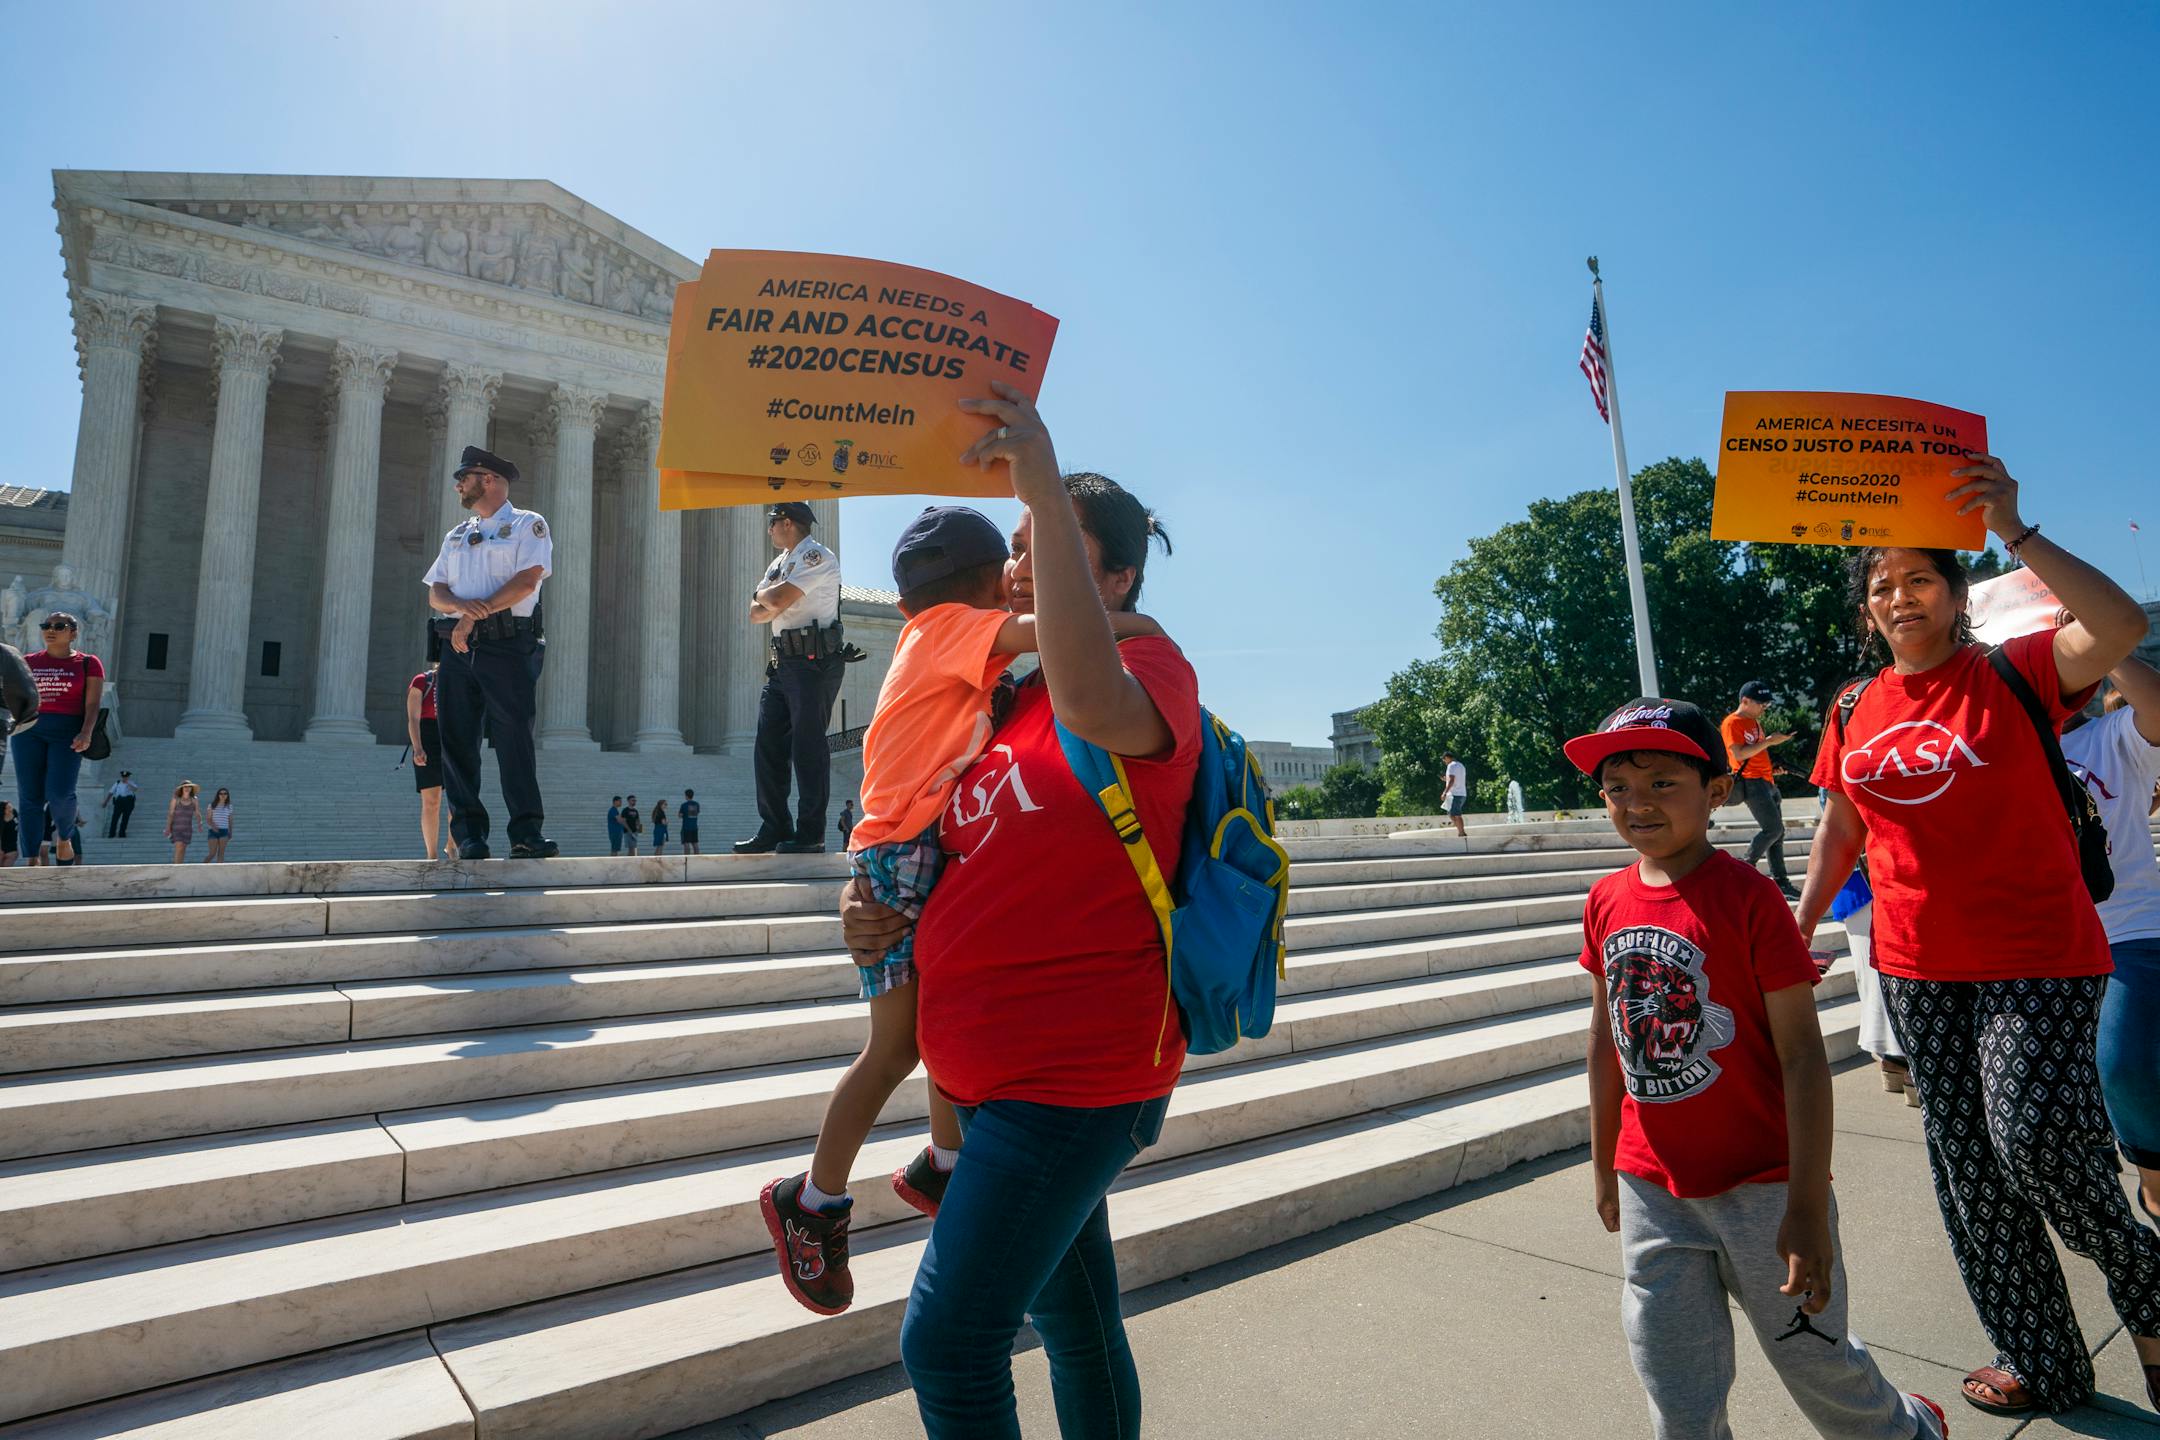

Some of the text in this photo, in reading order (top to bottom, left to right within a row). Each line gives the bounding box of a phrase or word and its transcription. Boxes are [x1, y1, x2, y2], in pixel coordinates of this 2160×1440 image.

[758, 279, 989, 327] AMERICA NEEDS A
[706, 307, 1031, 373] FAIR AND ACCURATE
[747, 345, 966, 380] #2020CENSUS
[767, 398, 915, 427] #CountMeIn
[1755, 418, 1957, 439] AMERICA NECESITA UN
[1726, 438, 1788, 452] CENSO
[1792, 438, 1854, 453] JUSTO
[1859, 440, 1915, 454] PARA
[1798, 472, 1900, 487] #Censo2020
[1796, 489, 1899, 505] #CountMeIn
[1842, 734, 1989, 784] CASA
[939, 762, 1044, 838] ASA
[1617, 932, 1679, 957] BUFFALO
[1645, 1062, 1708, 1095] BITTON
